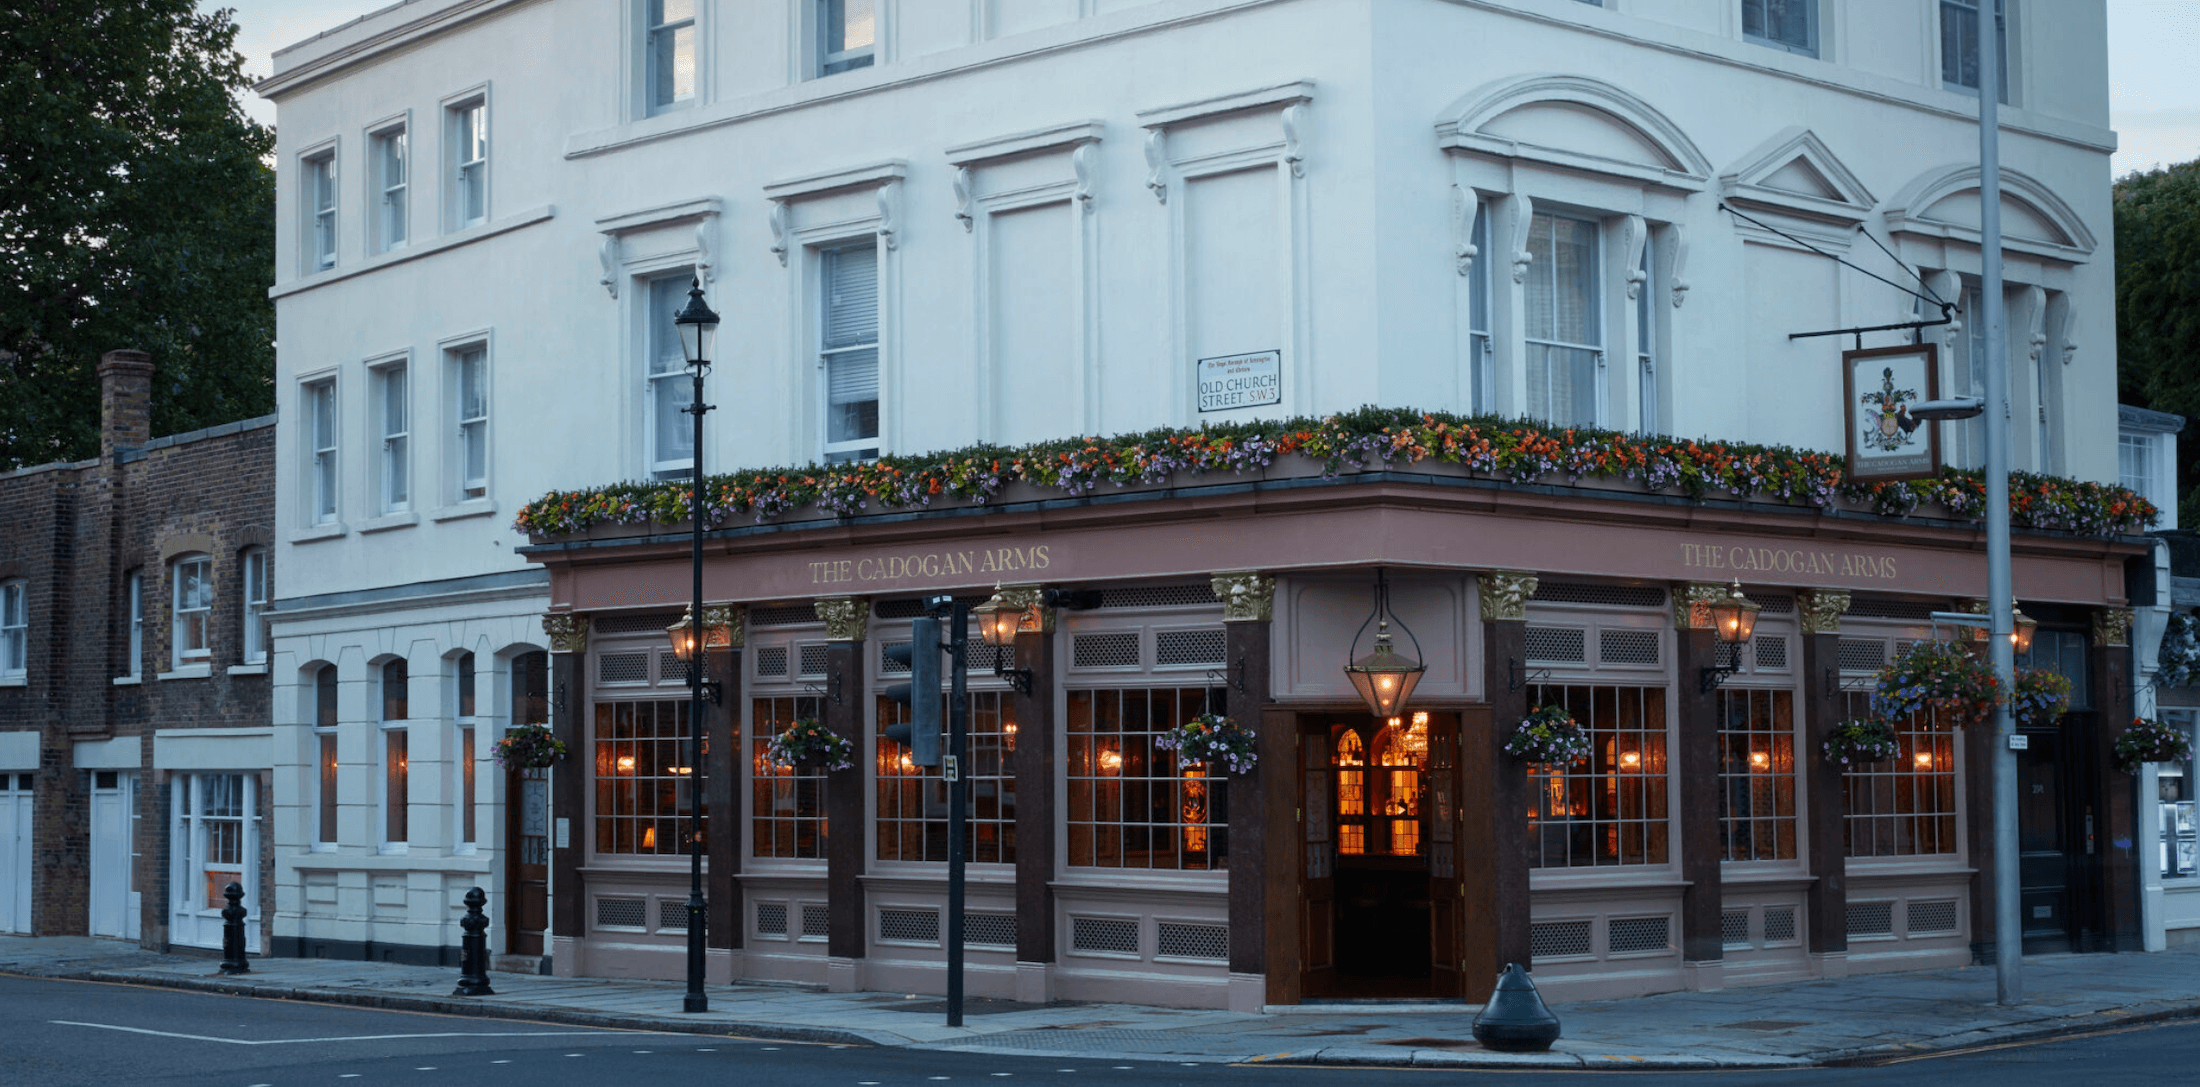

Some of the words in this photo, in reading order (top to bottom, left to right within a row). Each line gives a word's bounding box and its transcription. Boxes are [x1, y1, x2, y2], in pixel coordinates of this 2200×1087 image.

[1200, 381, 1223, 395] OLD
[1226, 374, 1277, 391] CHURCH
[809, 560, 852, 584] THE
[857, 551, 974, 581] CADOGAN
[980, 545, 1050, 573] ARMS
[1681, 543, 1725, 568] THE
[1729, 546, 1835, 575] CADOGAN
[1840, 553, 1897, 578] ARMS
